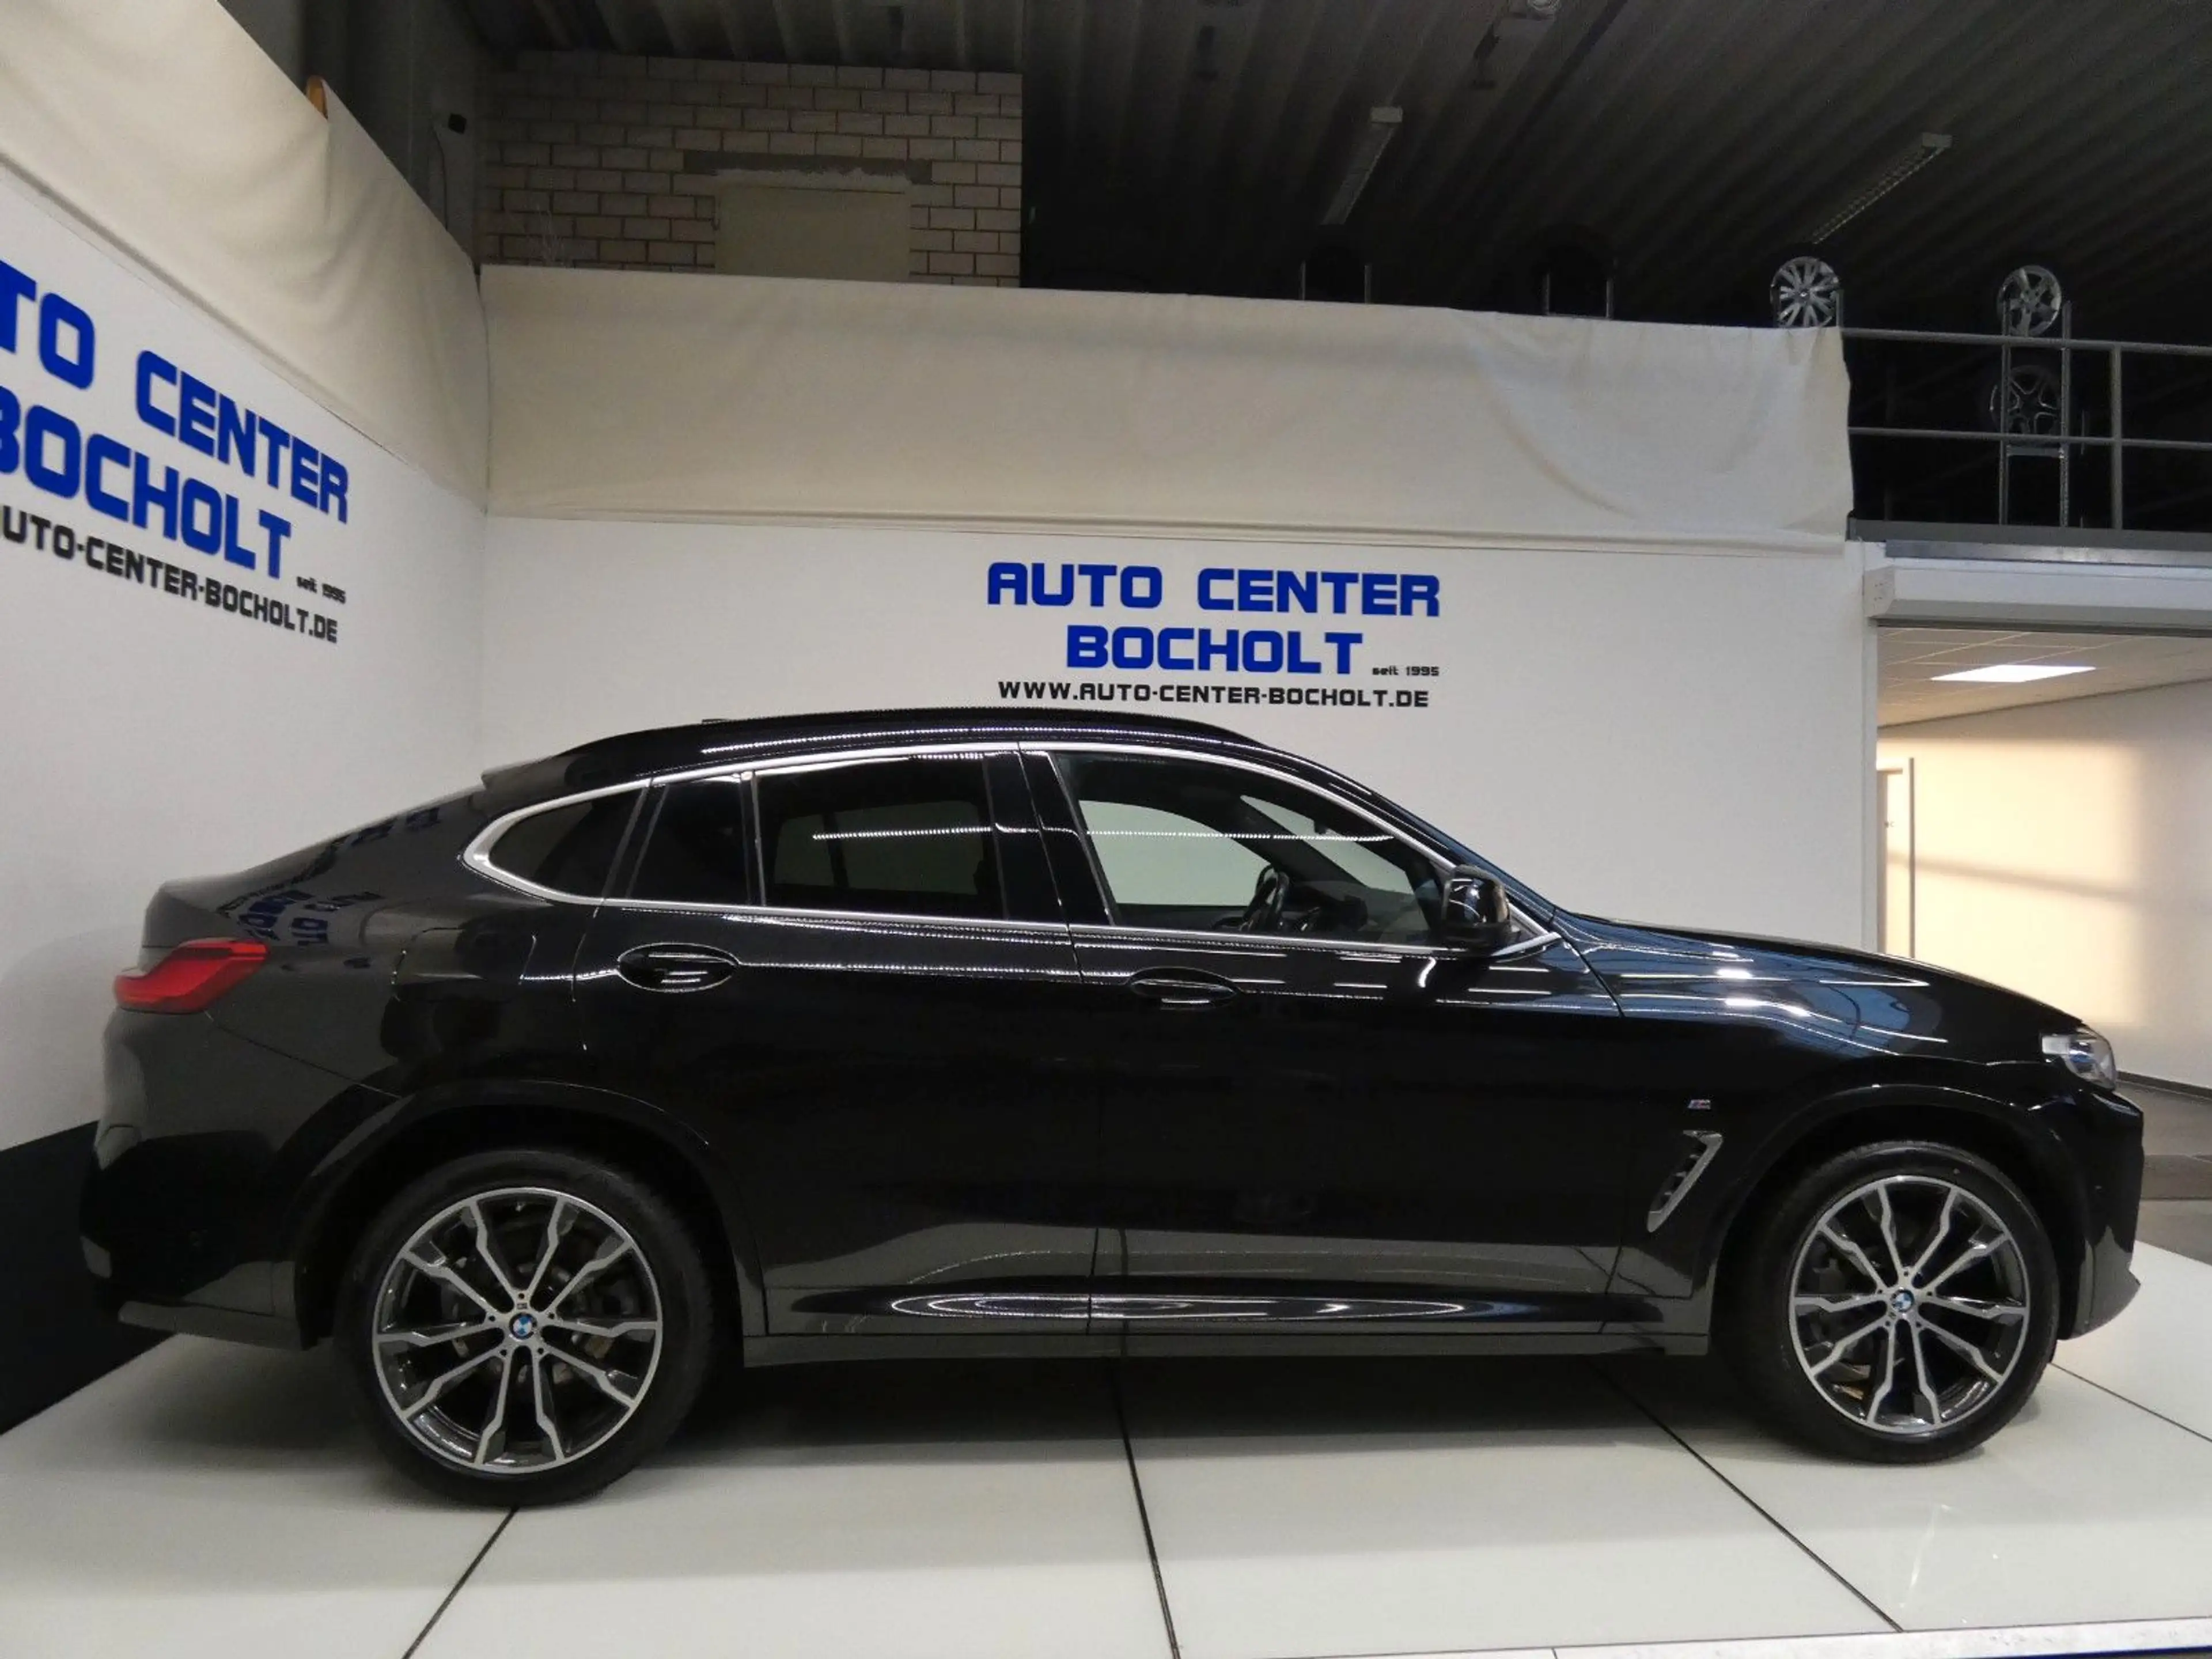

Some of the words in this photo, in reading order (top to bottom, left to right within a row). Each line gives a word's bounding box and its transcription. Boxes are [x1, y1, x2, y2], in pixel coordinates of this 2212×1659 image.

[135, 350, 349, 524] CENTER
[987, 562, 1164, 609] AUTO
[1197, 567, 1440, 618] CENTER
[1066, 624, 1365, 676] BOCHOLT
[1372, 665, 1399, 676] seit
[1406, 666, 1440, 677] 1995
[998, 681, 1429, 708] WWW.AUTO-CENTER-BOCHOLT.DE
